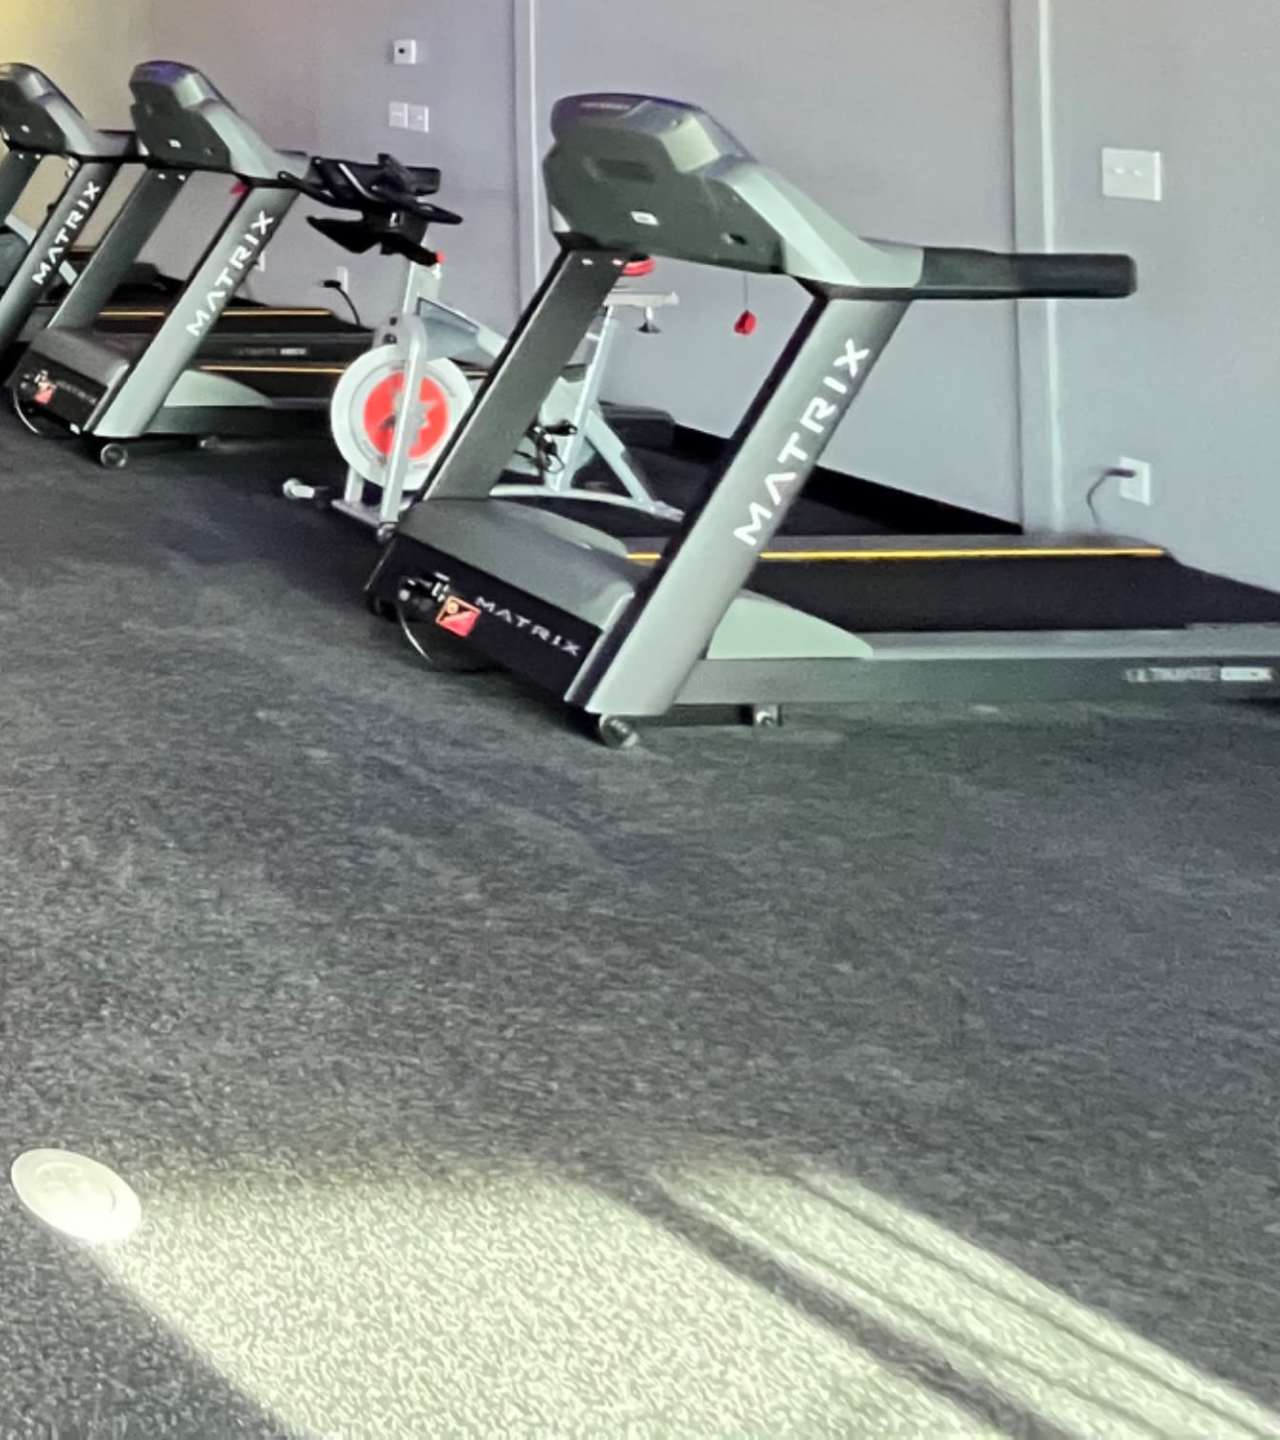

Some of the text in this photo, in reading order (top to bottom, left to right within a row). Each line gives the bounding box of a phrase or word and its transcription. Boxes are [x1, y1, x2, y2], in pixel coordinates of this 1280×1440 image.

[32, 181, 101, 286] MATRIX
[185, 210, 276, 338] MATRIX
[733, 339, 870, 547] MATRIX
[475, 595, 582, 657] MATRIX
